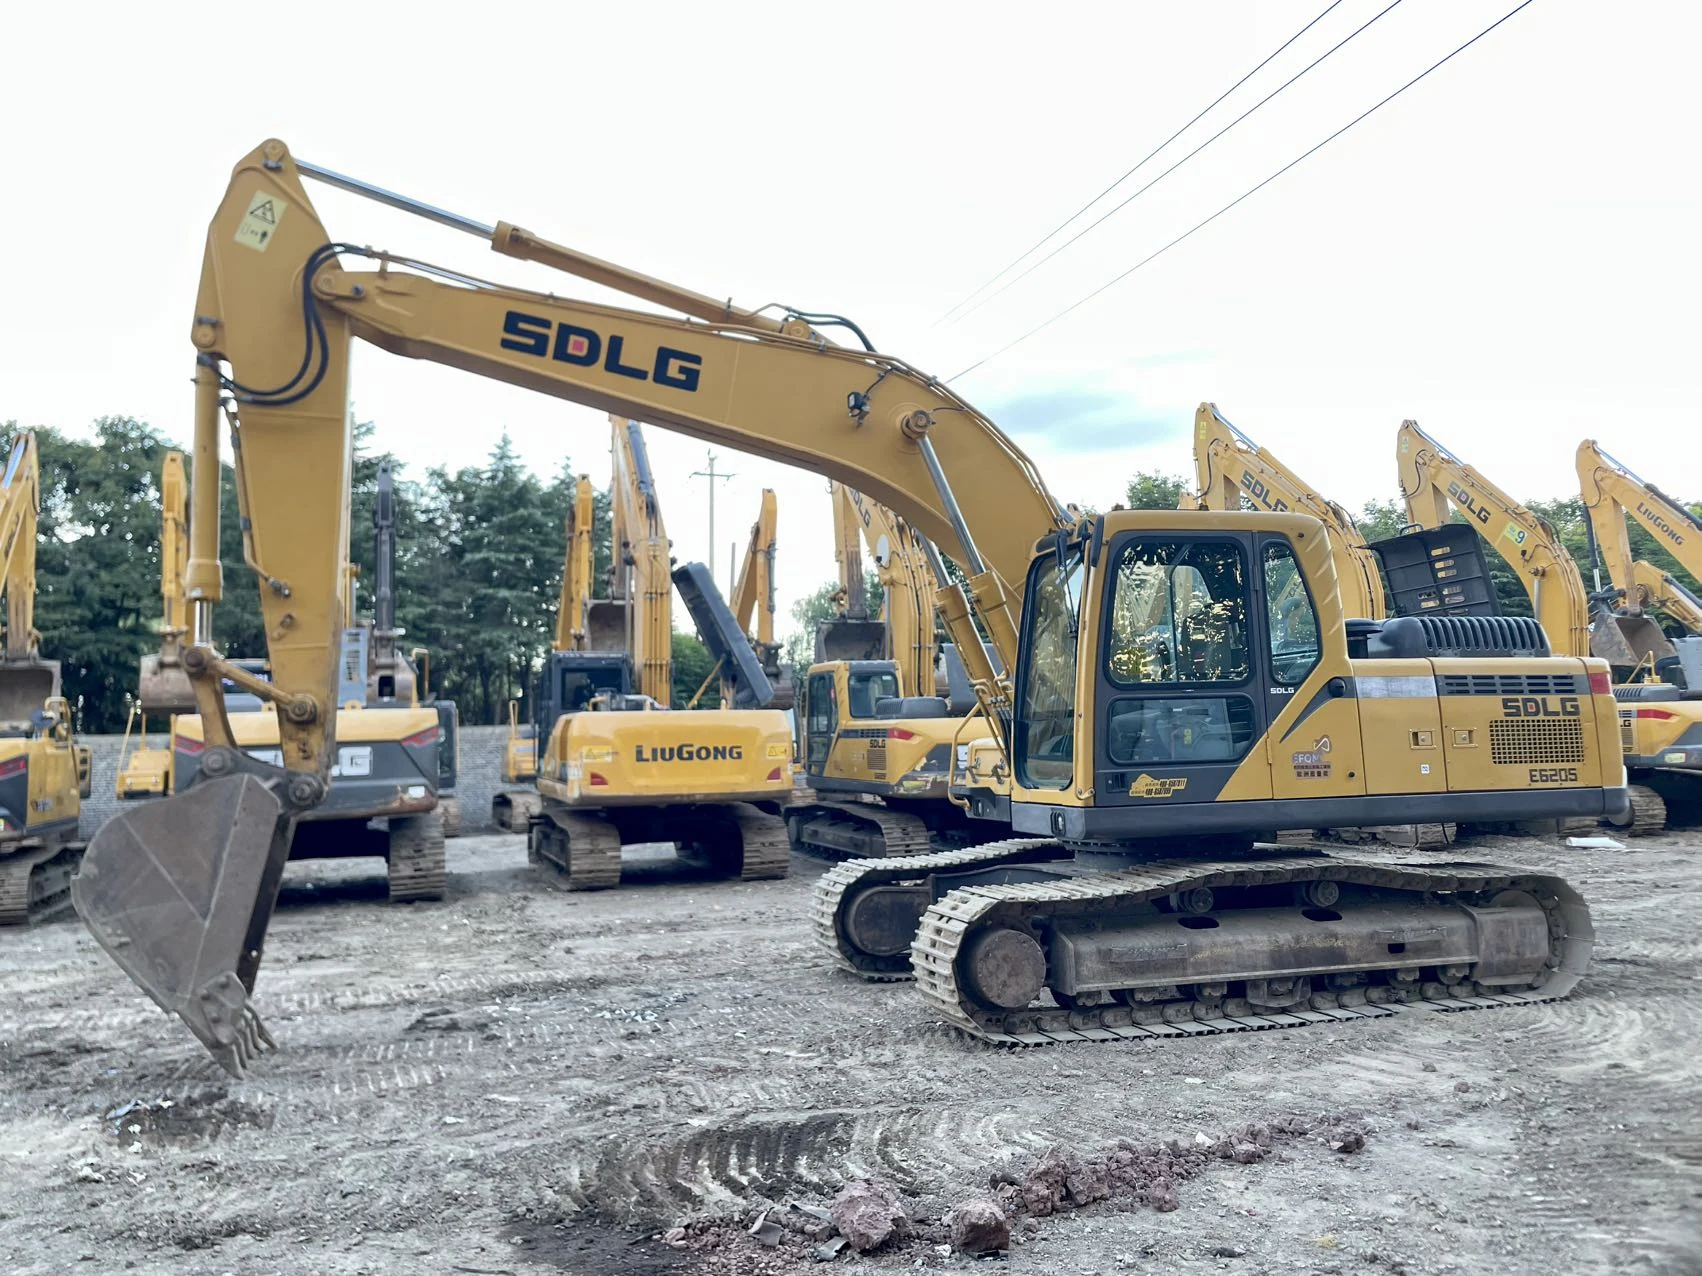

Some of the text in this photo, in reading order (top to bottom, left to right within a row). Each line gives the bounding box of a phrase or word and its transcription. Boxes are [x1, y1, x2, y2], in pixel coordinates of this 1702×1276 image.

[501, 310, 702, 392] SDLG
[1447, 480, 1491, 525] SDLG
[1502, 697, 1580, 717] SDLG
[870, 739, 886, 748] SDLG
